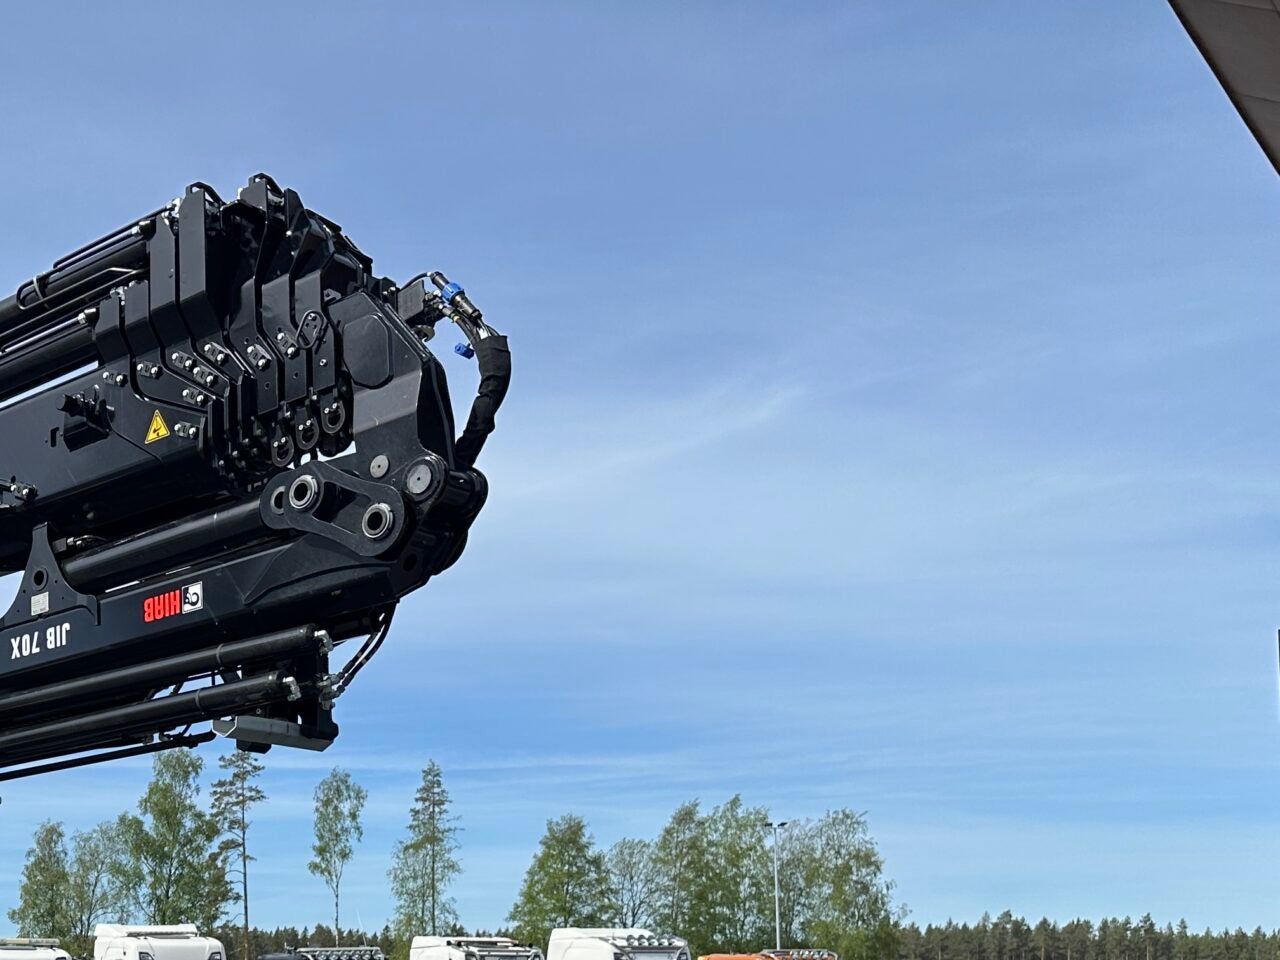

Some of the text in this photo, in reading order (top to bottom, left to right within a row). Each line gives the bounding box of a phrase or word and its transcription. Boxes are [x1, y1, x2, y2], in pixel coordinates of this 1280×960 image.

[143, 589, 181, 623] HIAB
[10, 622, 71, 661] JIB 70X
